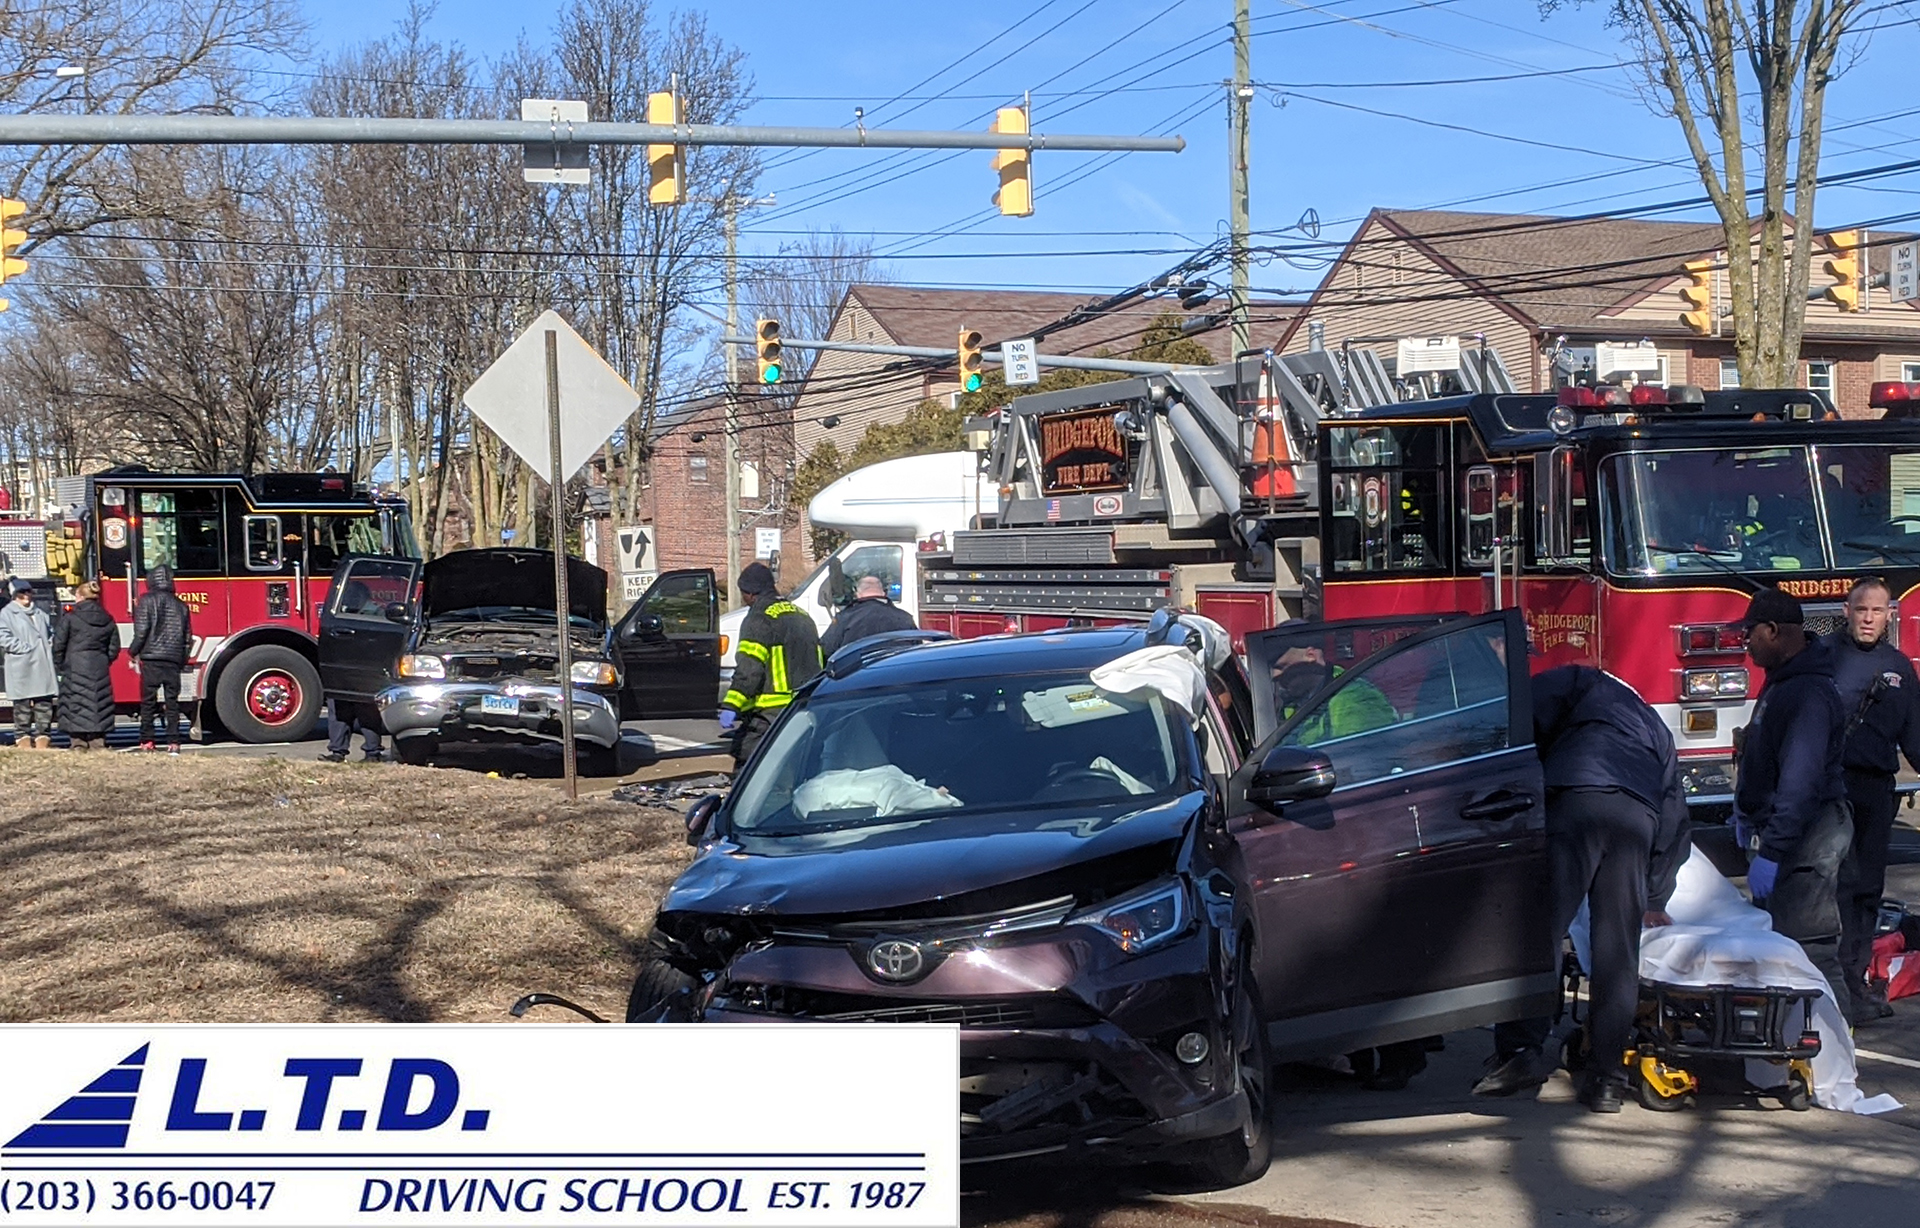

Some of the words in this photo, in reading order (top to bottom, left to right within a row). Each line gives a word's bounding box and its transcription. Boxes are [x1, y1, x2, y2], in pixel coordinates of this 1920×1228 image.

[1898, 246, 1910, 259] NO
[1897, 261, 1912, 271] TURN
[1900, 274, 1909, 284] ON
[1898, 286, 1910, 297] RED
[1011, 343, 1025, 352] NO
[1011, 354, 1030, 362] TURN
[1015, 363, 1026, 371] ON
[1057, 465, 1080, 486] FIRE
[627, 576, 654, 587] KEEP
[626, 588, 646, 598] RIG
[1778, 578, 1854, 597] BRIDGEP
[175, 592, 209, 604] GINE
[1538, 614, 1597, 635] BRIDGEPORT
[1542, 632, 1565, 653] FIRE
